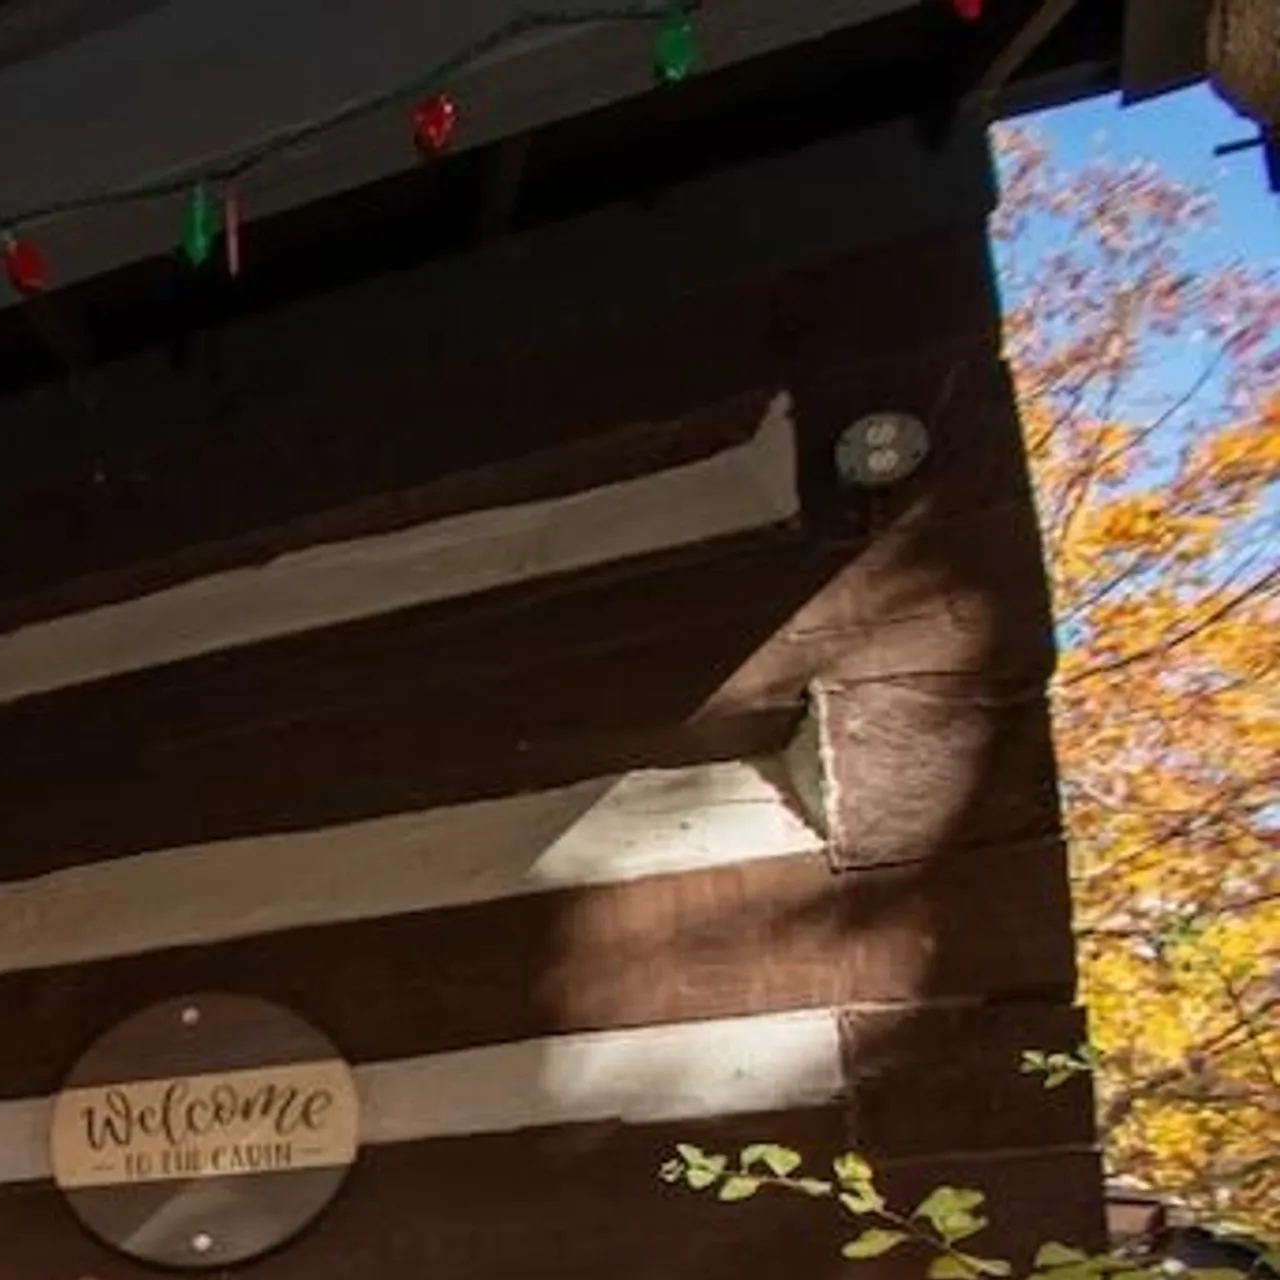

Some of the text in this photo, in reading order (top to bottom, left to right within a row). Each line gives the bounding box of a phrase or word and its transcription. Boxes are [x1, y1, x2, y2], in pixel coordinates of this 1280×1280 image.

[81, 1083, 333, 1151] Welcome
[124, 1142, 294, 1177] TO THE CABIN
